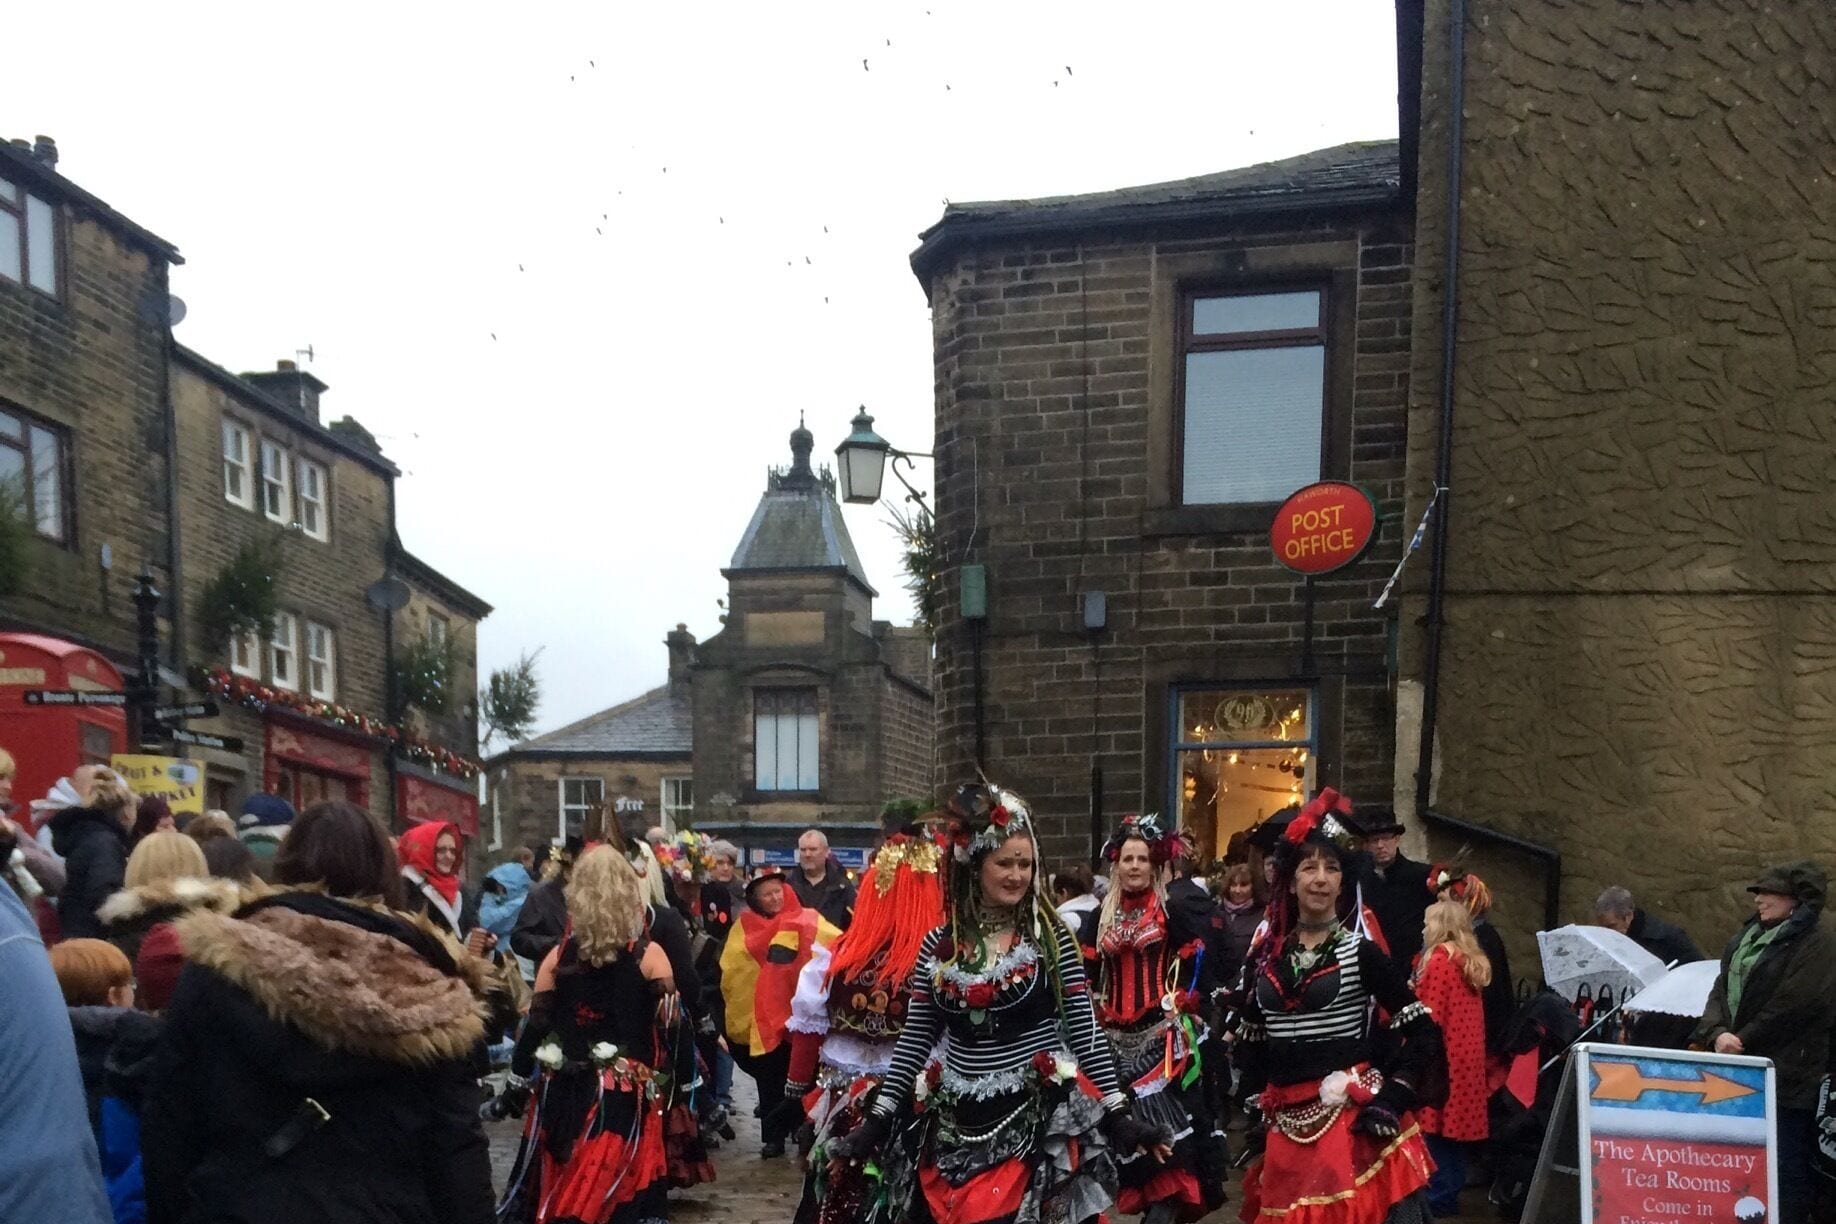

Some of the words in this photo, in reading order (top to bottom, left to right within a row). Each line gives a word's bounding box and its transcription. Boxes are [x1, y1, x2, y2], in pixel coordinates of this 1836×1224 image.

[1292, 504, 1345, 534] POST
[1285, 528, 1354, 559] OFFICE
[1594, 1139, 1635, 1160] The
[1641, 1143, 1757, 1174] Apothecary
[1621, 1167, 1659, 1188] Tea
[1666, 1170, 1731, 1193] Rooms
[1643, 1197, 1691, 1215] Come
[1696, 1199, 1713, 1216] in
